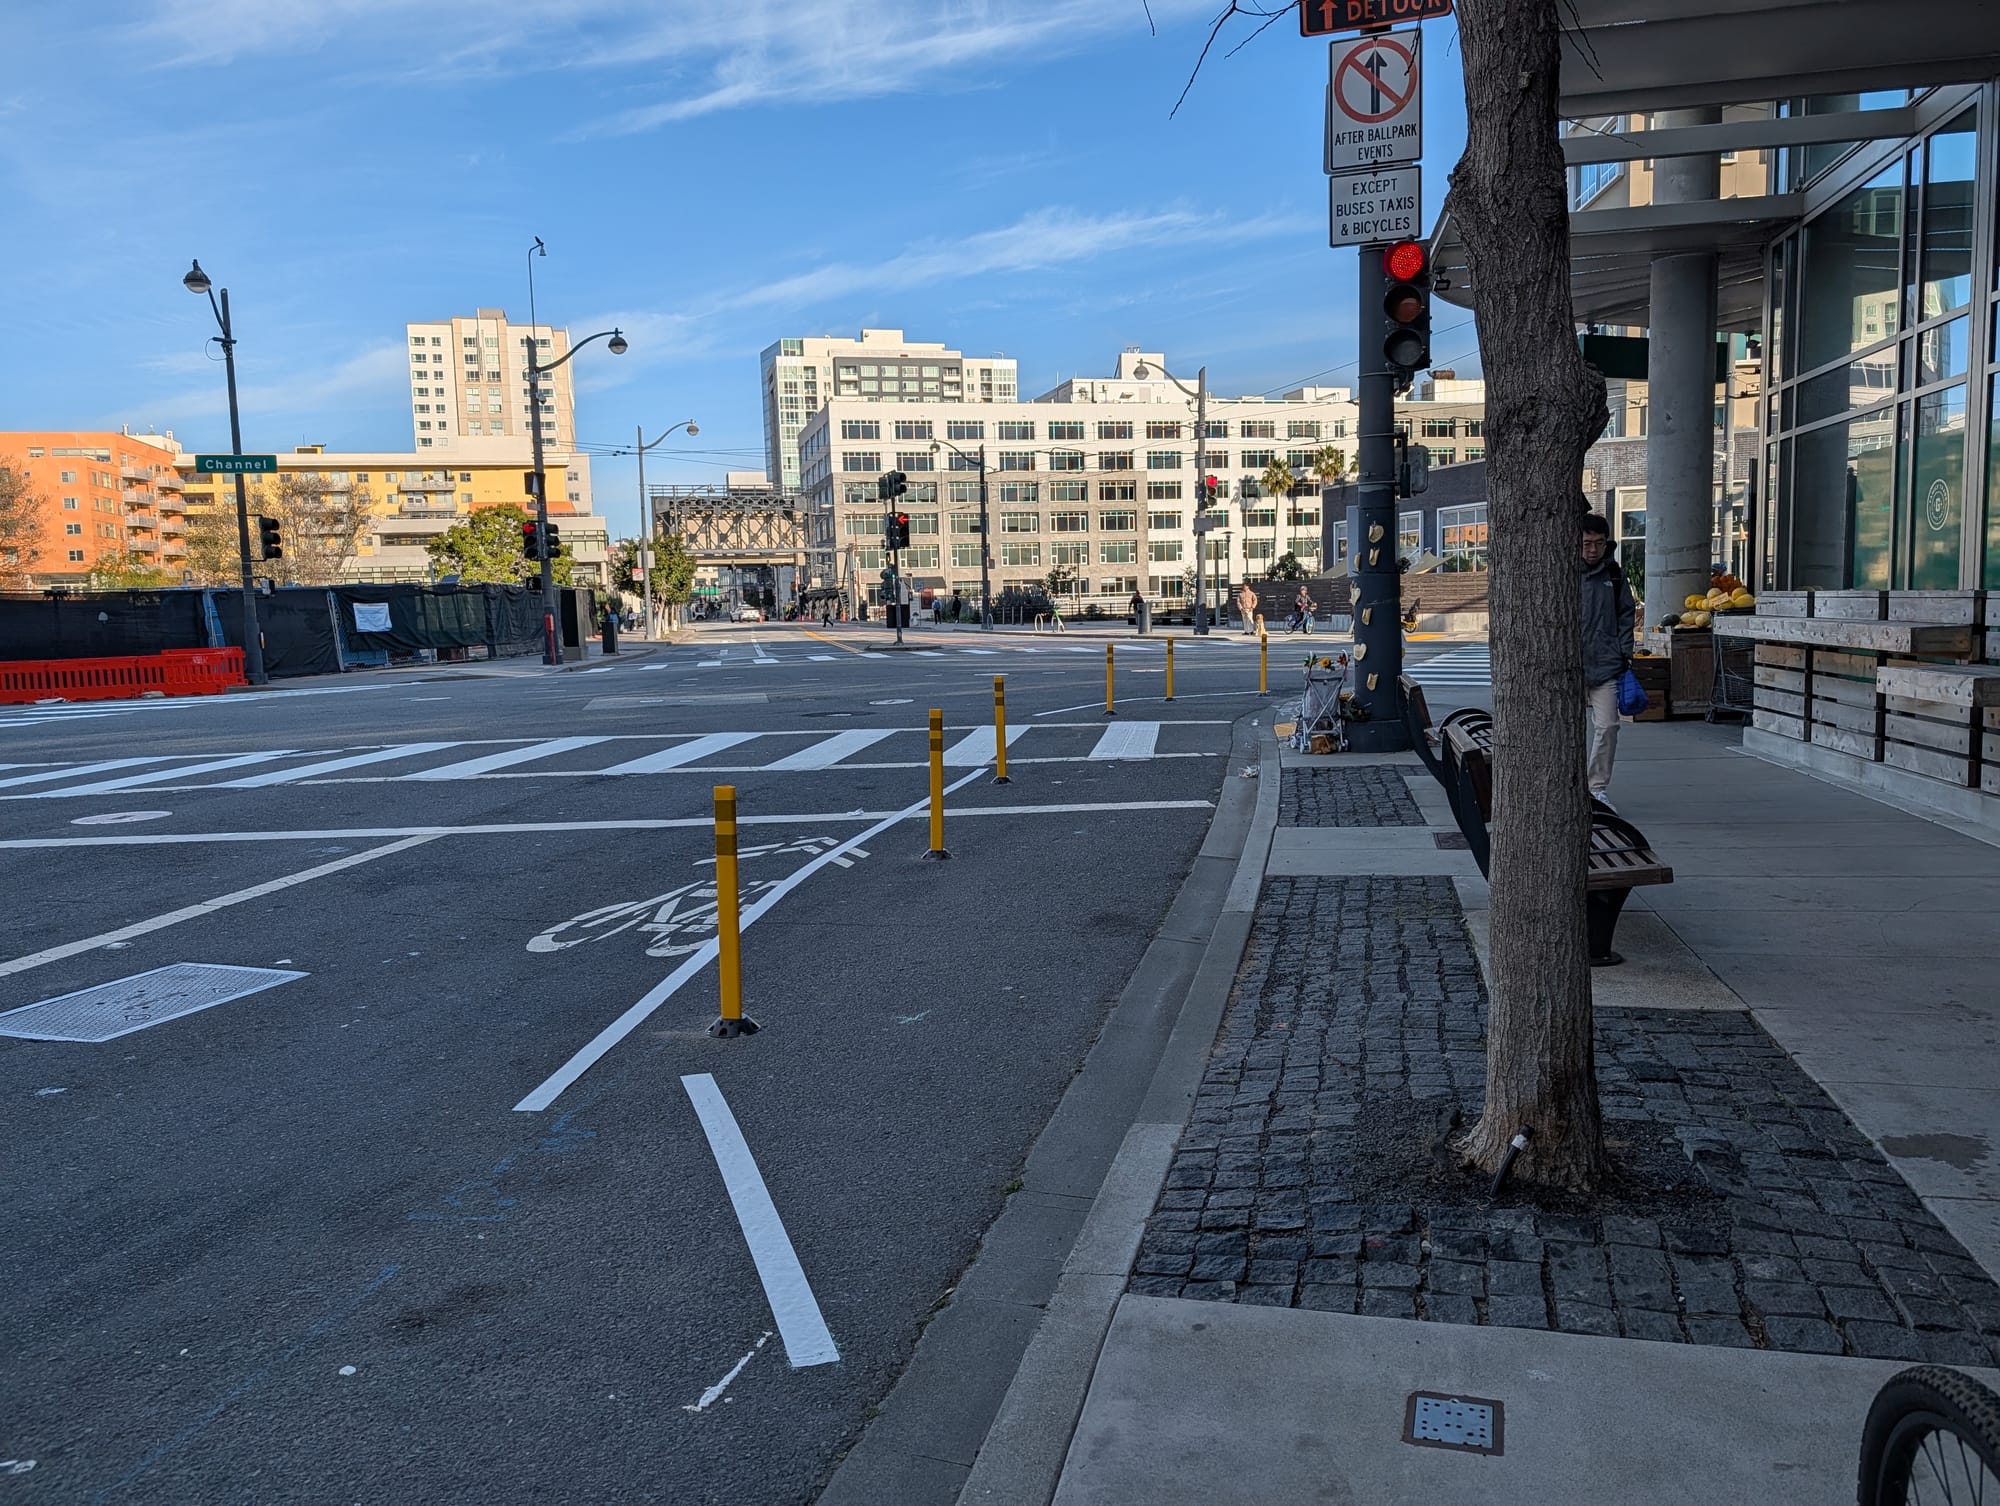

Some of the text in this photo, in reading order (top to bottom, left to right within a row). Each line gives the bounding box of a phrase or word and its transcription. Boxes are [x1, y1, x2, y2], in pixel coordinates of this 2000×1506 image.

[1335, 123, 1417, 146] AFTER BALLPARK
[1358, 144, 1393, 160] EVENTS
[1352, 178, 1398, 196] EXCEPT
[1336, 196, 1414, 217] BUSES TAXIS
[1341, 217, 1410, 236] & BICYCLES
[205, 459, 267, 469] Channel
